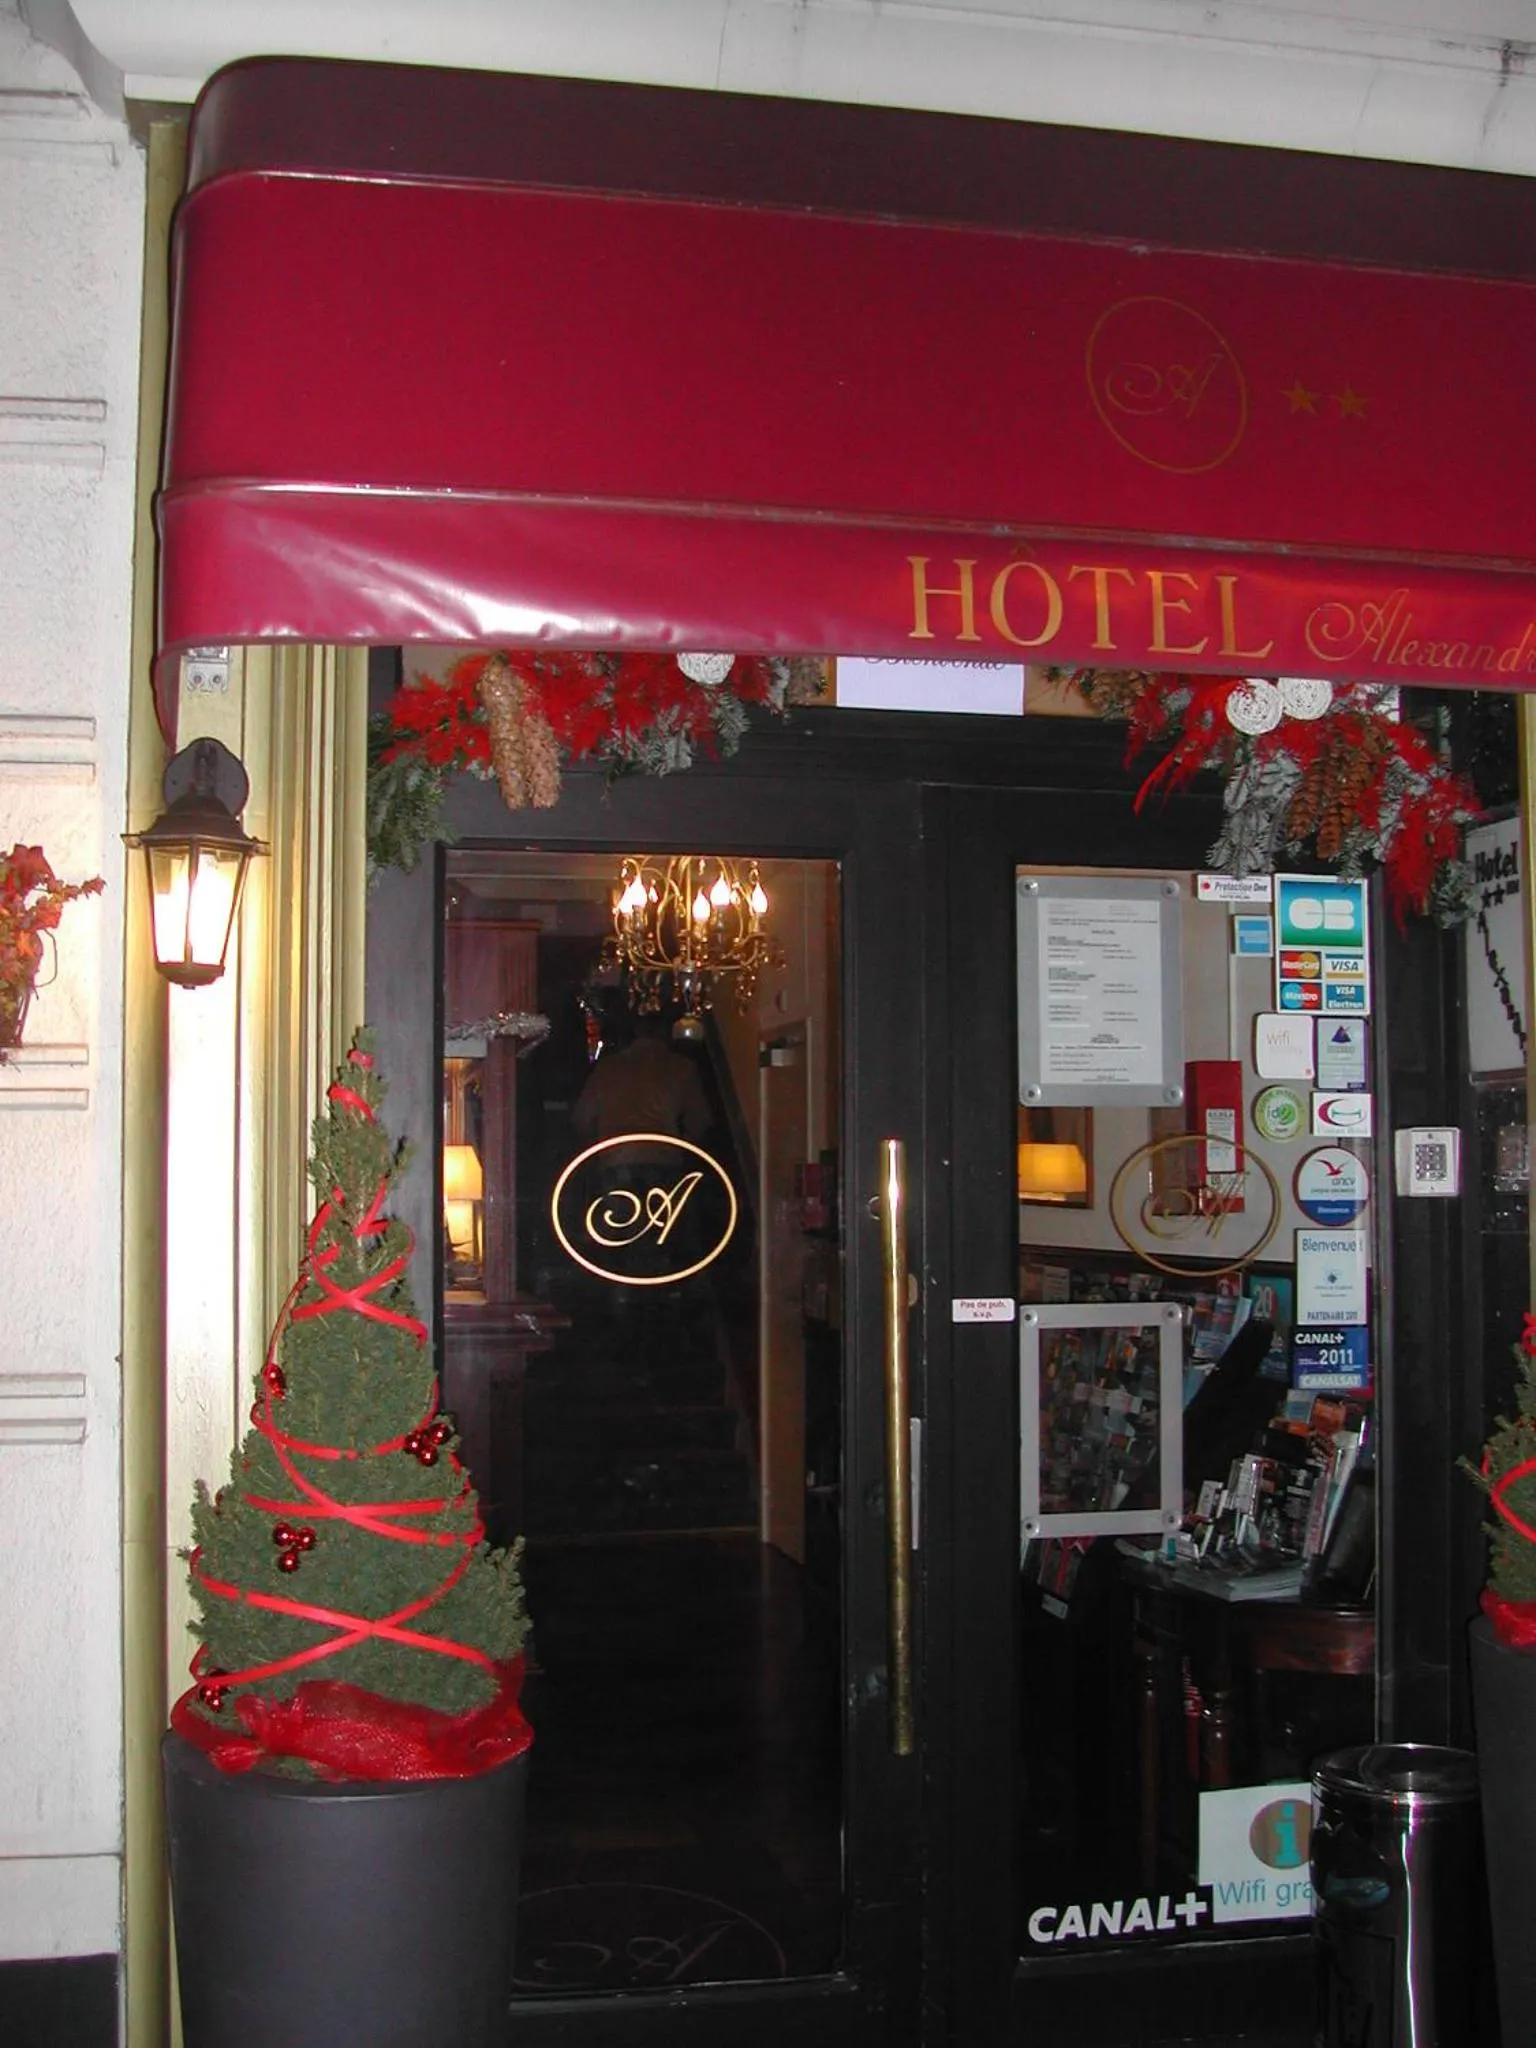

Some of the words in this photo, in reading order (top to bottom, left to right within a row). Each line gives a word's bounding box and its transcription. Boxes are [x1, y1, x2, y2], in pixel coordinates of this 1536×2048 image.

[906, 546, 1275, 659] HÔTEL
[1474, 841, 1519, 884] Hotel
[1330, 960, 1360, 971] VISA
[1266, 1030, 1291, 1046] Wifi
[1302, 1238, 1357, 1252] Bienvenue
[977, 1300, 987, 1308] de
[1294, 1332, 1345, 1345] CANAL+
[1319, 1348, 1354, 1366] 2011
[1216, 1879, 1266, 1907] Wifi
[1027, 1891, 1208, 1944] CANAL+
